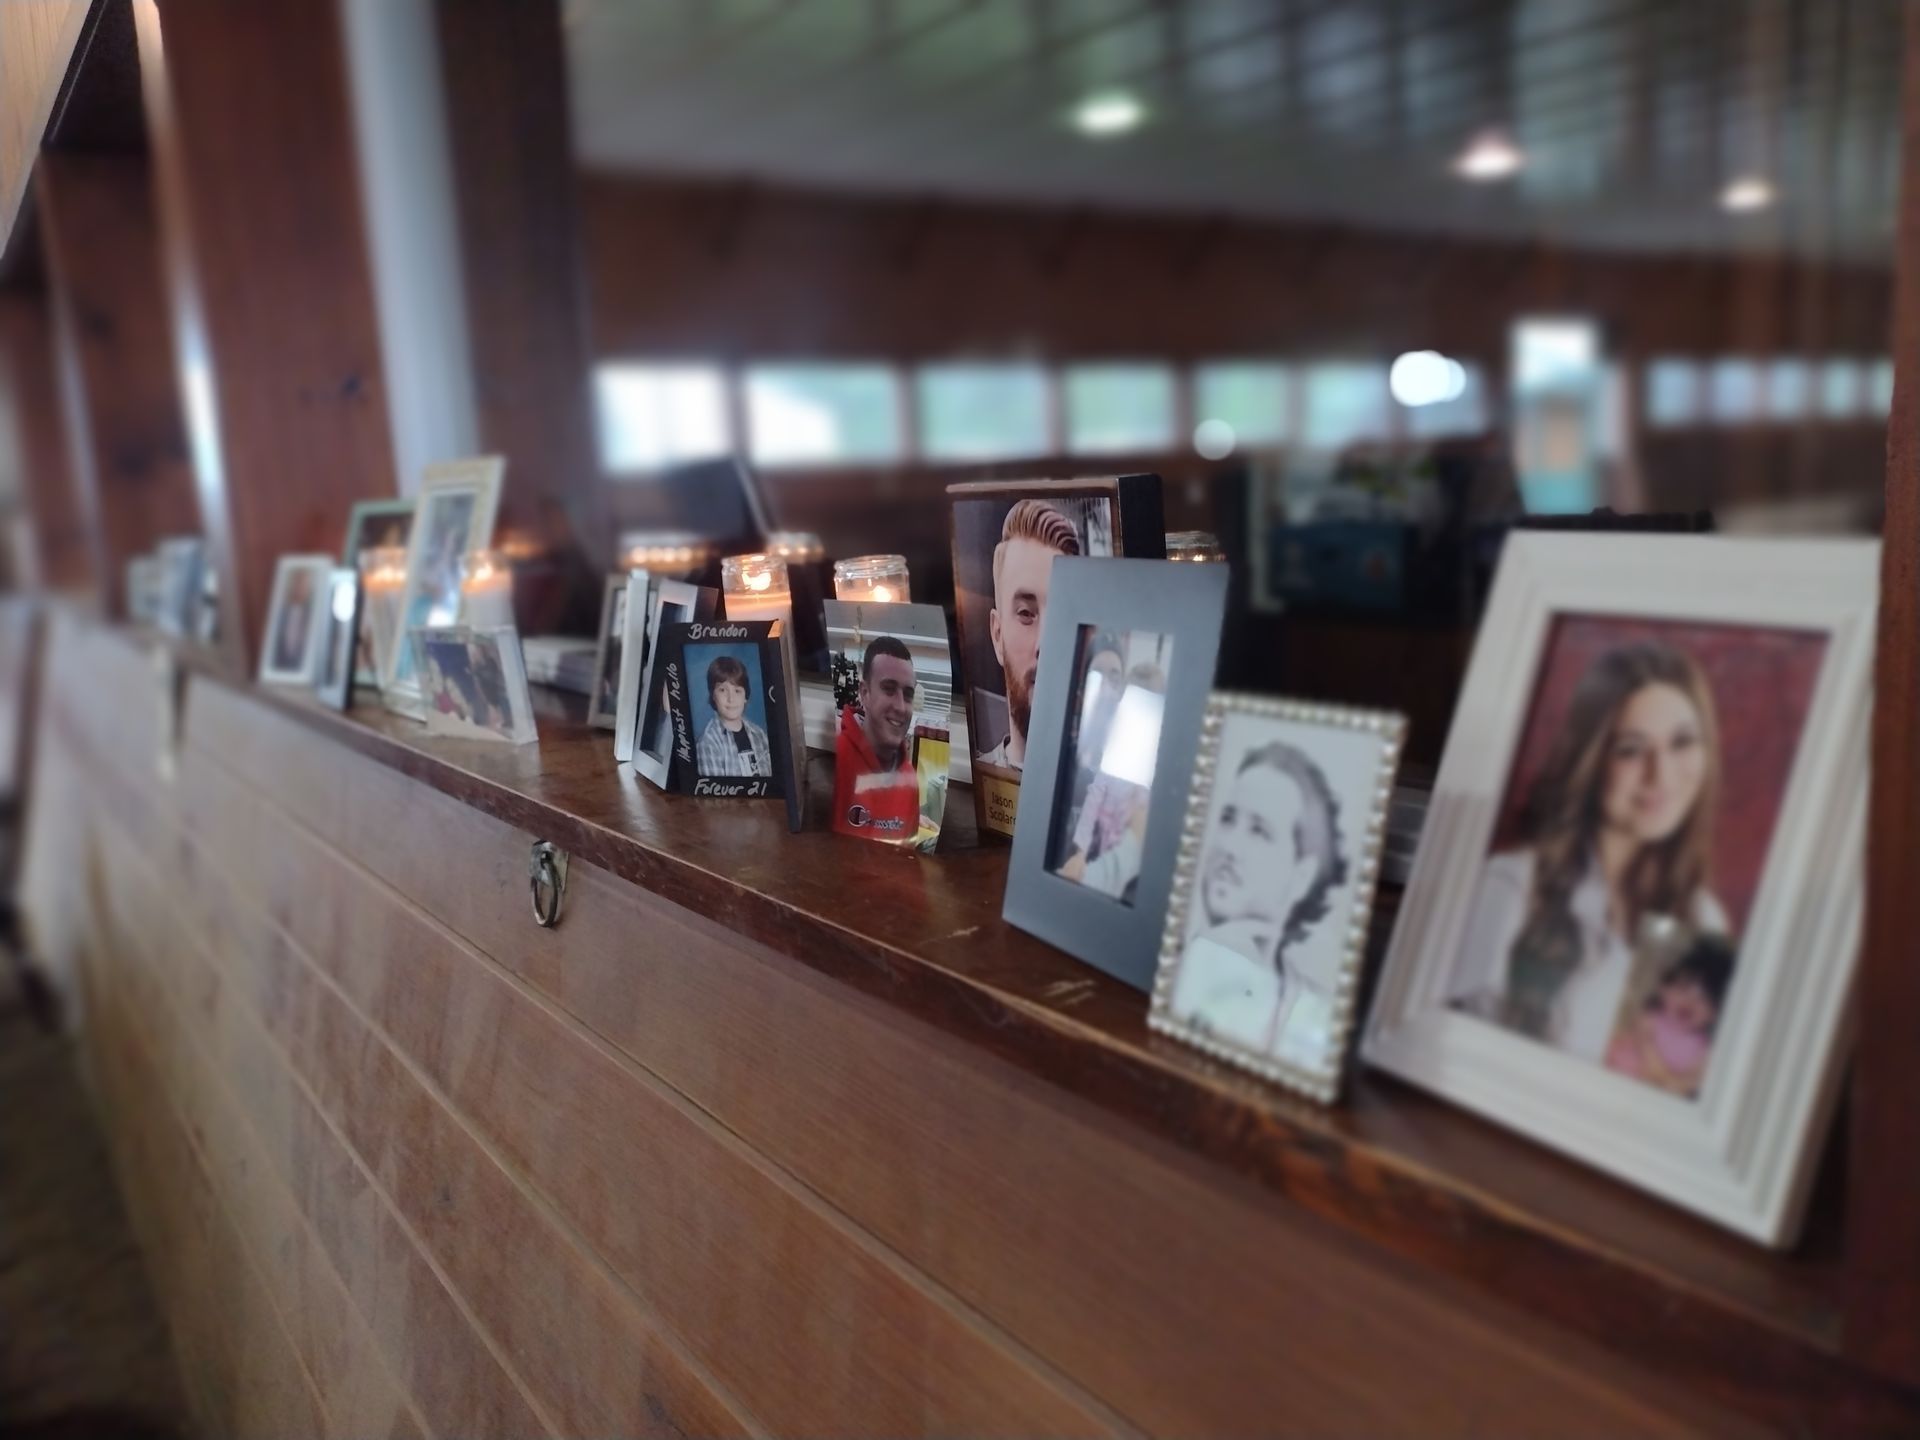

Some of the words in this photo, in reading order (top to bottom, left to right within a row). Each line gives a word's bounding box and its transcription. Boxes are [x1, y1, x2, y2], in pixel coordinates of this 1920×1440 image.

[687, 623, 748, 640] Brandon
[666, 662, 681, 701] hello
[672, 708, 692, 763] Happiest
[694, 778, 744, 796] Forever
[747, 781, 767, 796] 21
[991, 791, 1014, 809] Jason
